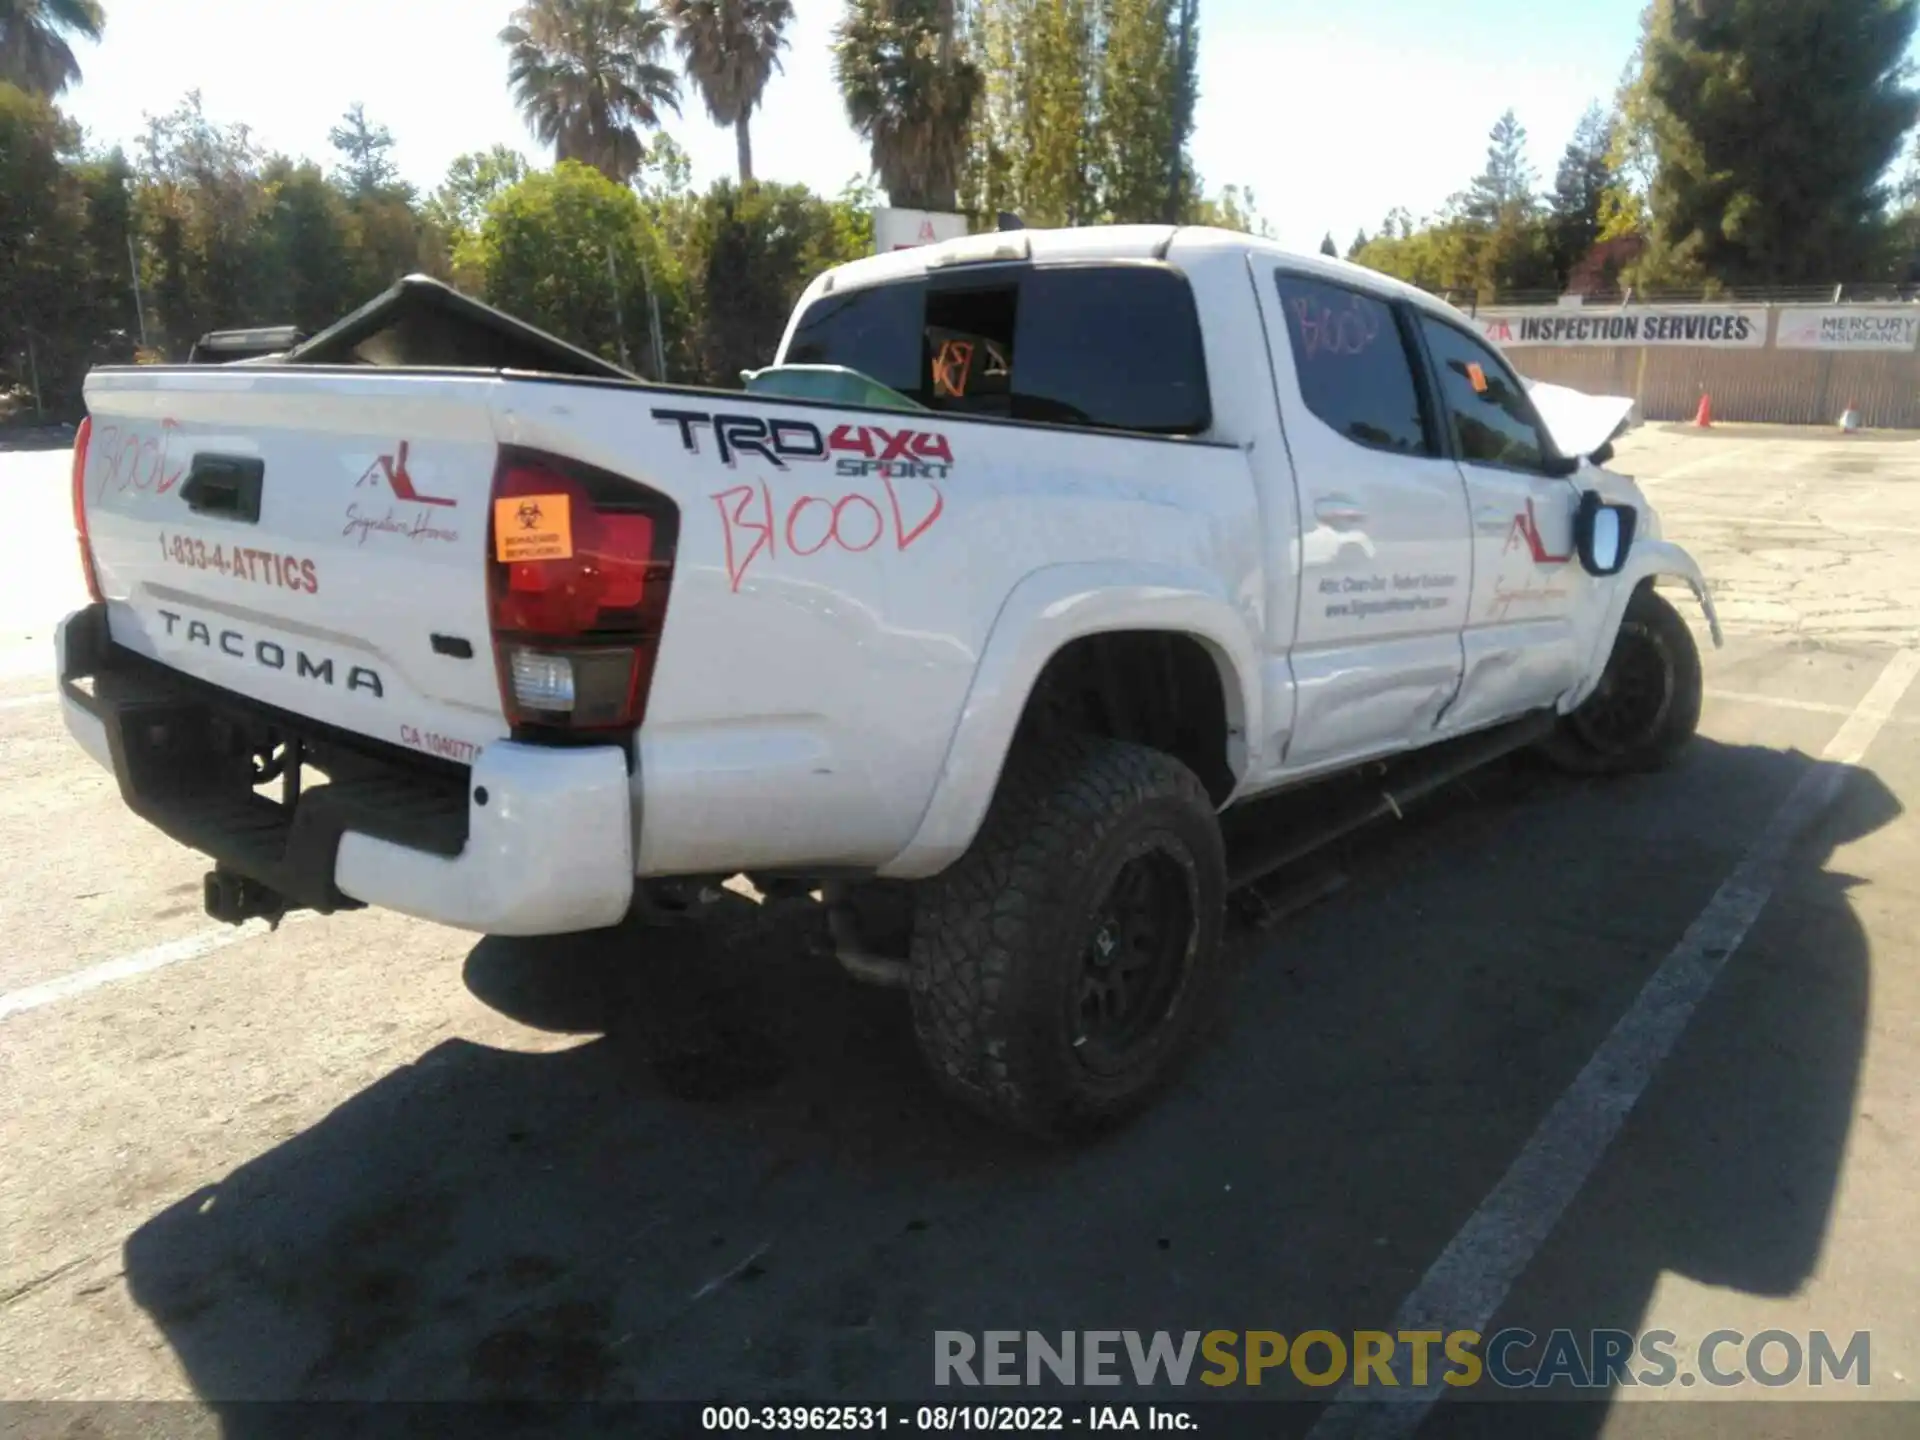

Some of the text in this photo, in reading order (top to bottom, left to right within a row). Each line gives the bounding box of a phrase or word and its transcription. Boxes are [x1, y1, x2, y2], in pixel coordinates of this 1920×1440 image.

[1519, 317, 1639, 341] INSPECTION
[1643, 315, 1750, 341] SERVICES
[1821, 316, 1917, 330] MERCURY
[649, 407, 830, 472] TRD
[835, 458, 954, 480] SPORT
[158, 530, 318, 594] 1-833-4-ATTICS
[158, 608, 384, 699] TACOMA
[400, 723, 421, 747] CA
